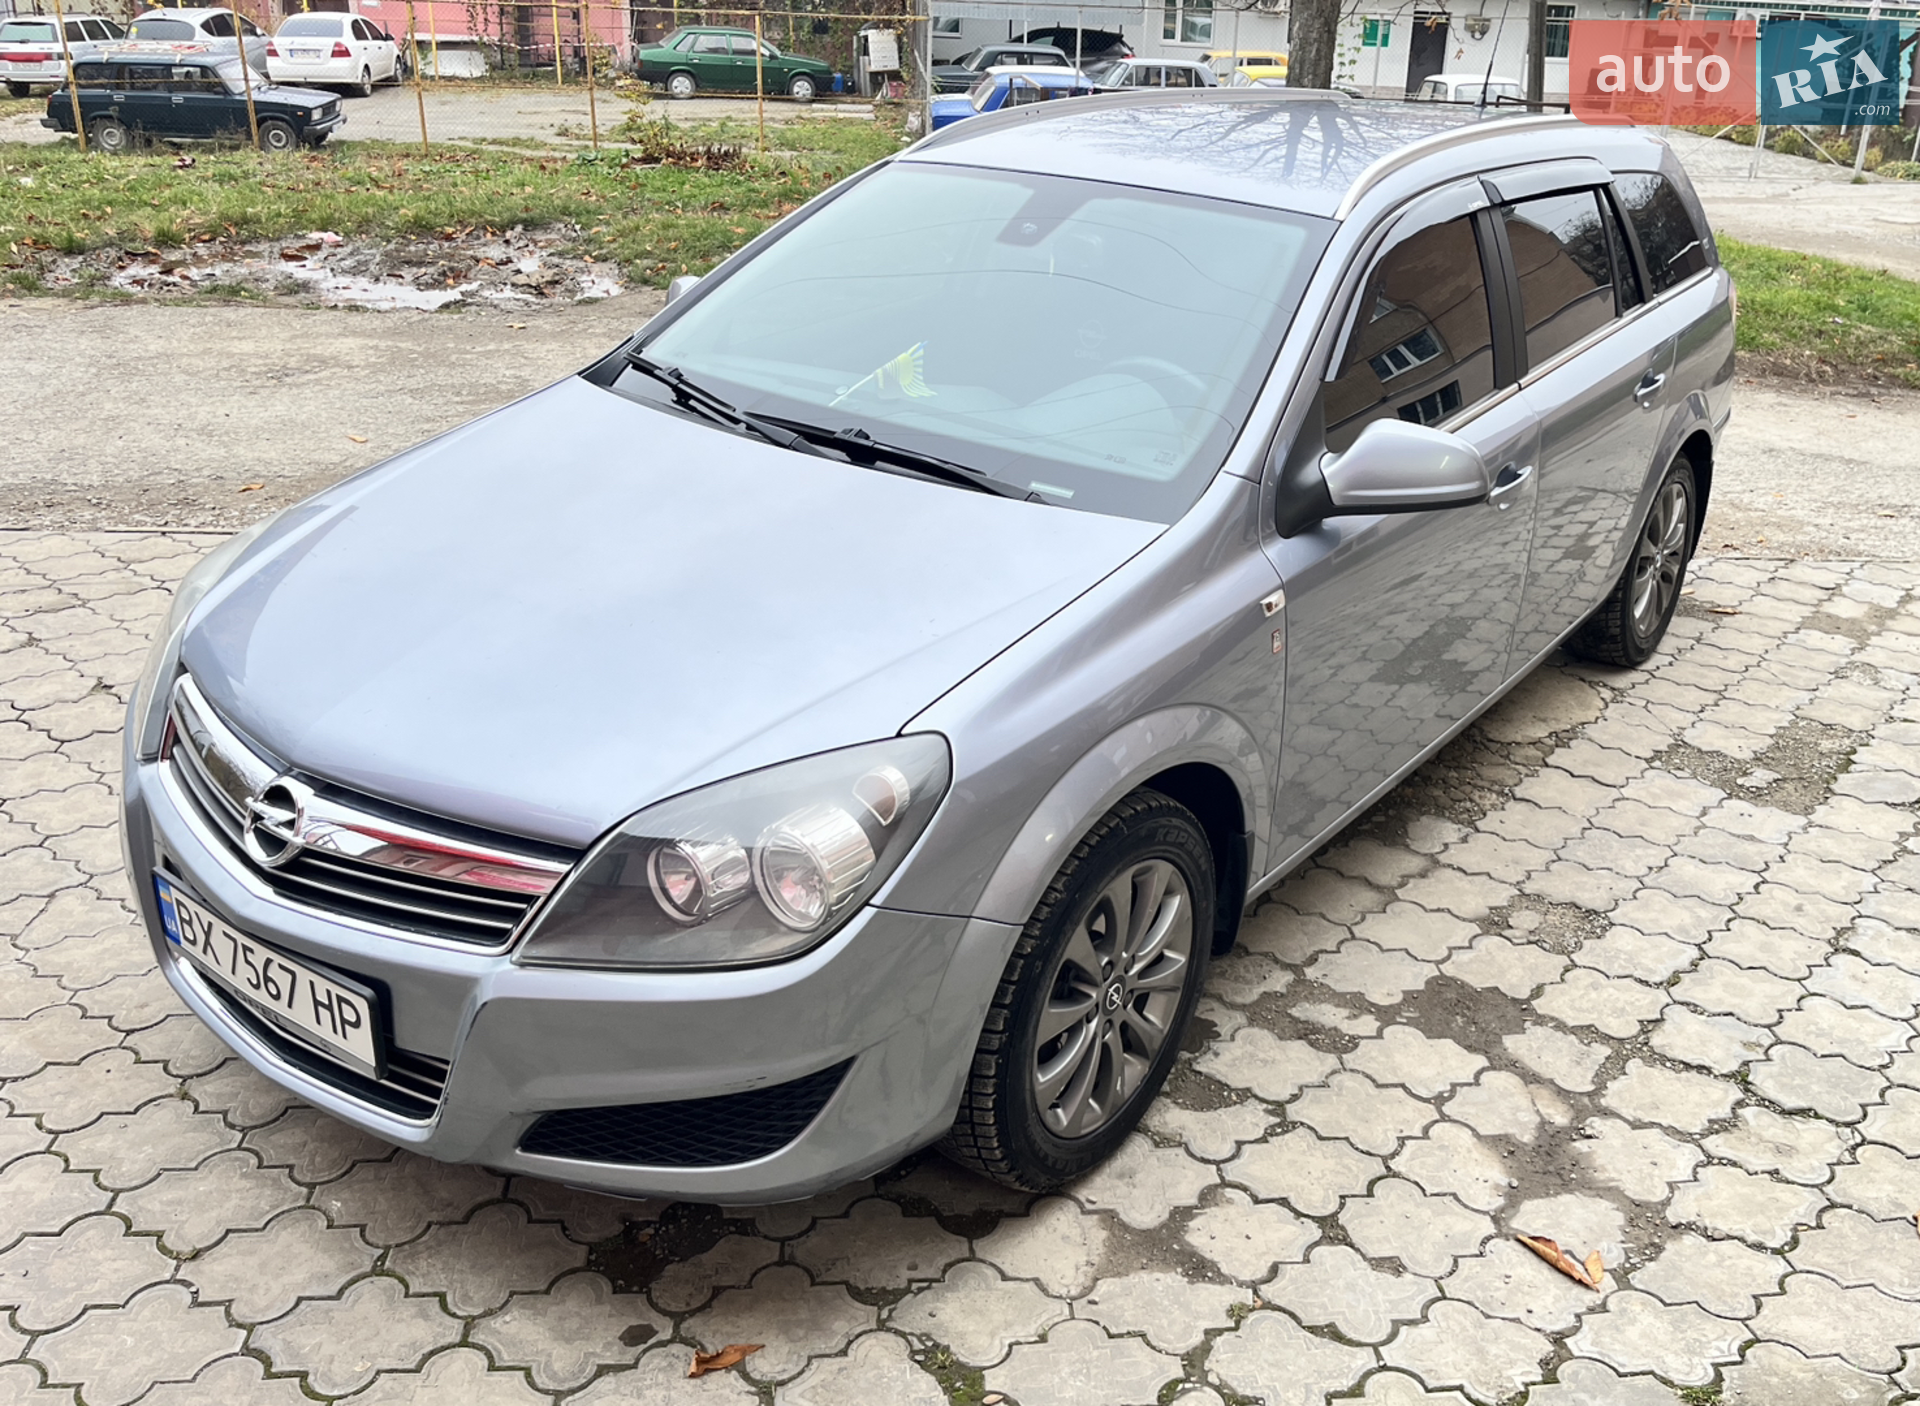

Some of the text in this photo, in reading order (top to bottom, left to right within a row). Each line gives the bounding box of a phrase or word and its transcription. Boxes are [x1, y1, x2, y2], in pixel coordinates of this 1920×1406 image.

[163, 914, 179, 934] UA
[175, 896, 362, 1040] BX 7567 HP
